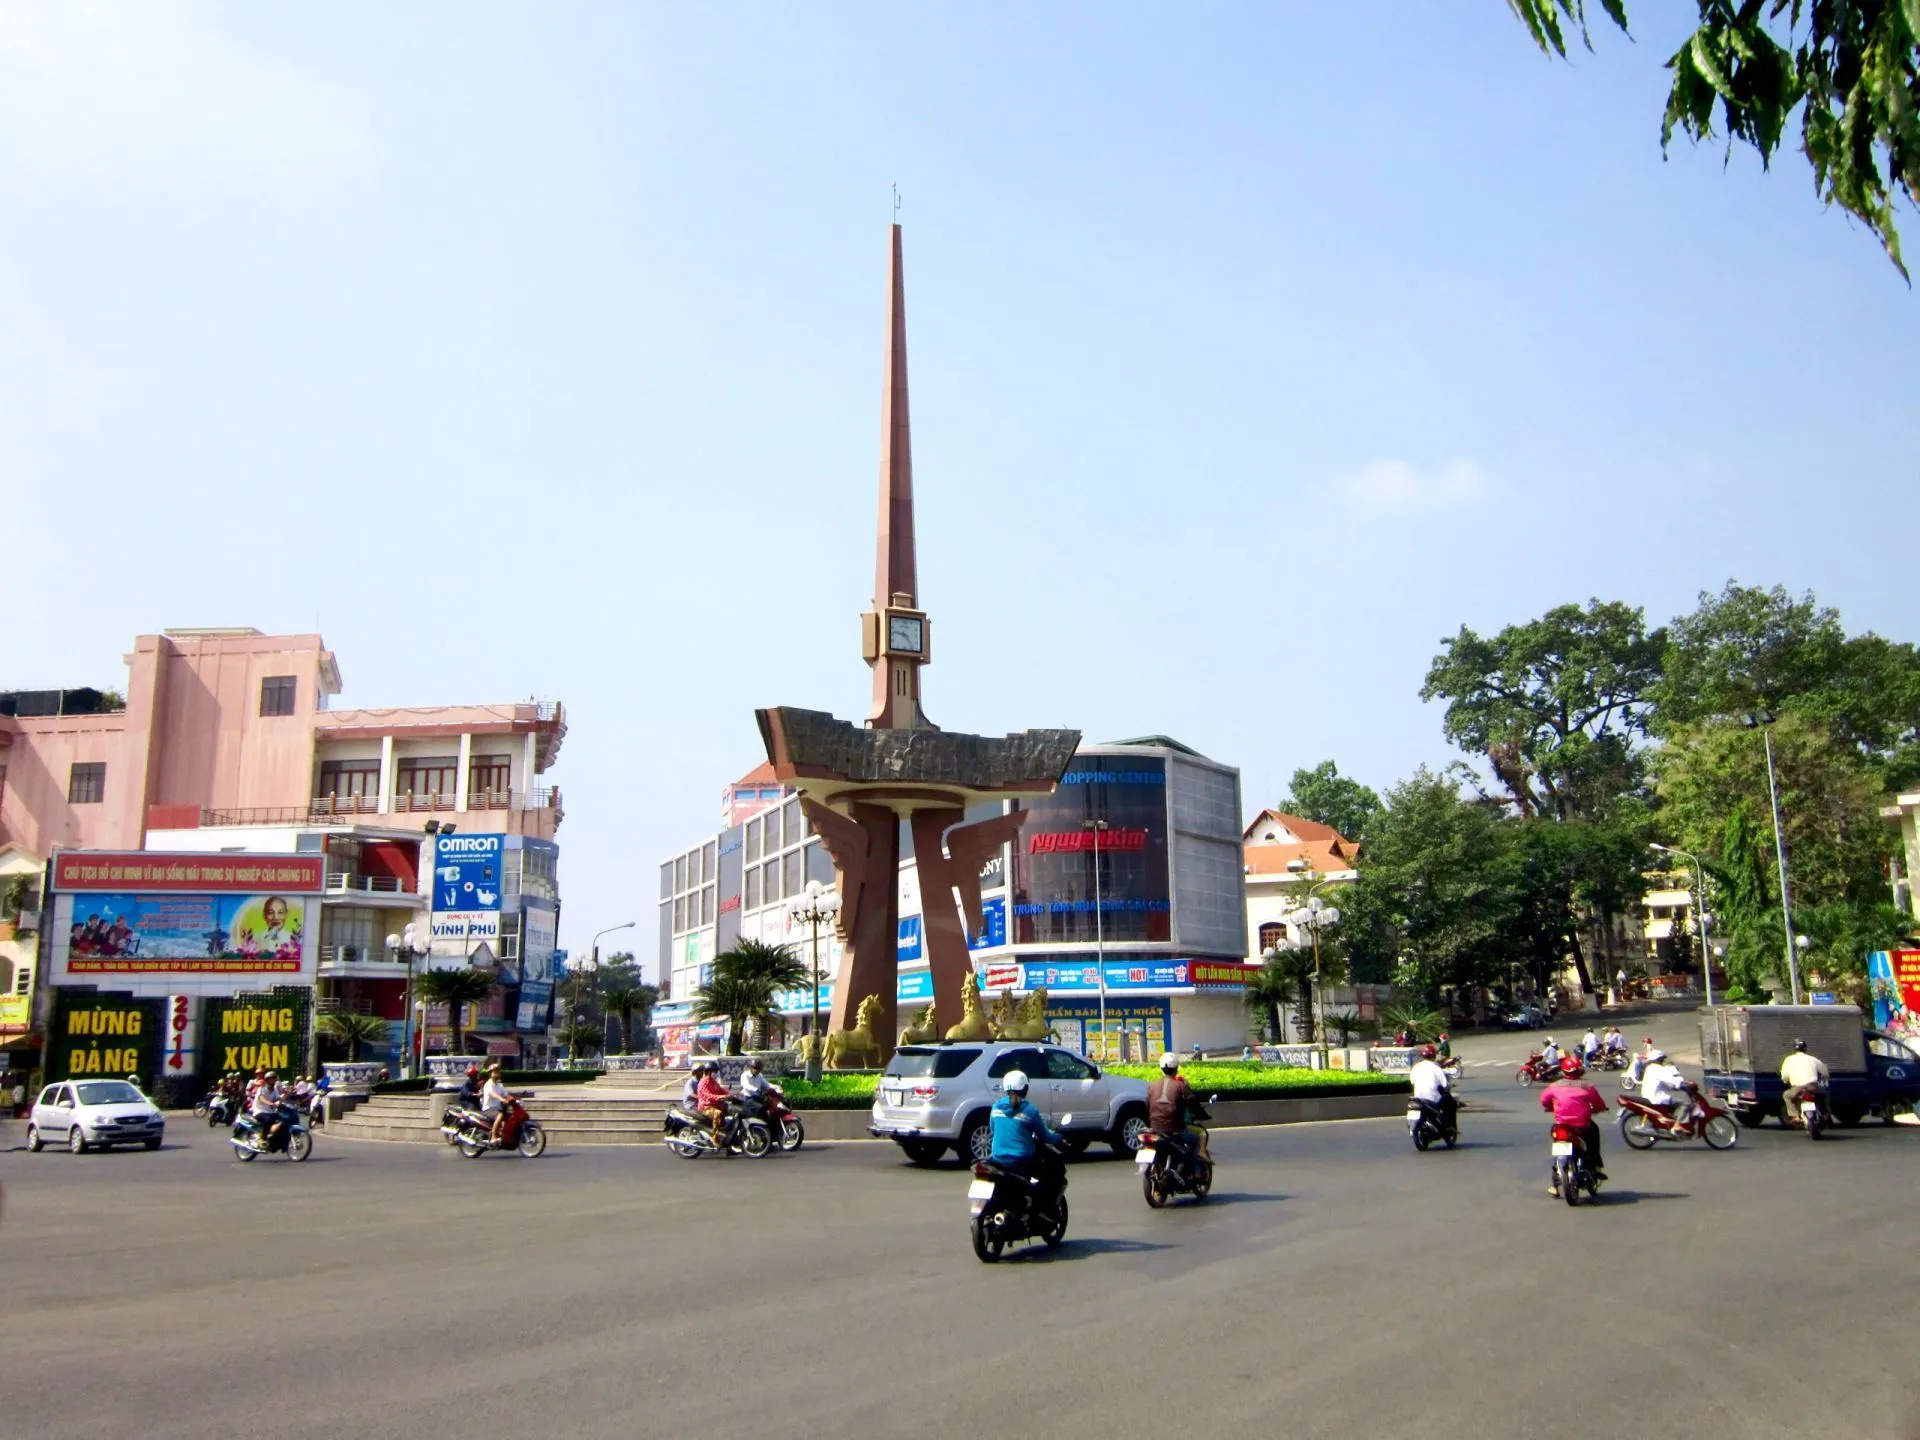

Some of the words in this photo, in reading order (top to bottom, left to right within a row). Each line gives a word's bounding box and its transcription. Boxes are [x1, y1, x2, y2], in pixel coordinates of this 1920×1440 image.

[1061, 771, 1116, 784] HOPPING
[1118, 772, 1165, 784] CENTER
[979, 857, 1003, 877] NY
[1013, 903, 1044, 915] TRUNG
[432, 922, 464, 935] VĨNH
[1130, 968, 1146, 981] HOT
[68, 1005, 141, 1035] MỪNG
[222, 1005, 293, 1033] MỪNG
[169, 995, 189, 1069] 2014
[69, 1040, 138, 1073] ĐẢNG
[223, 1043, 288, 1070] XUÂN
